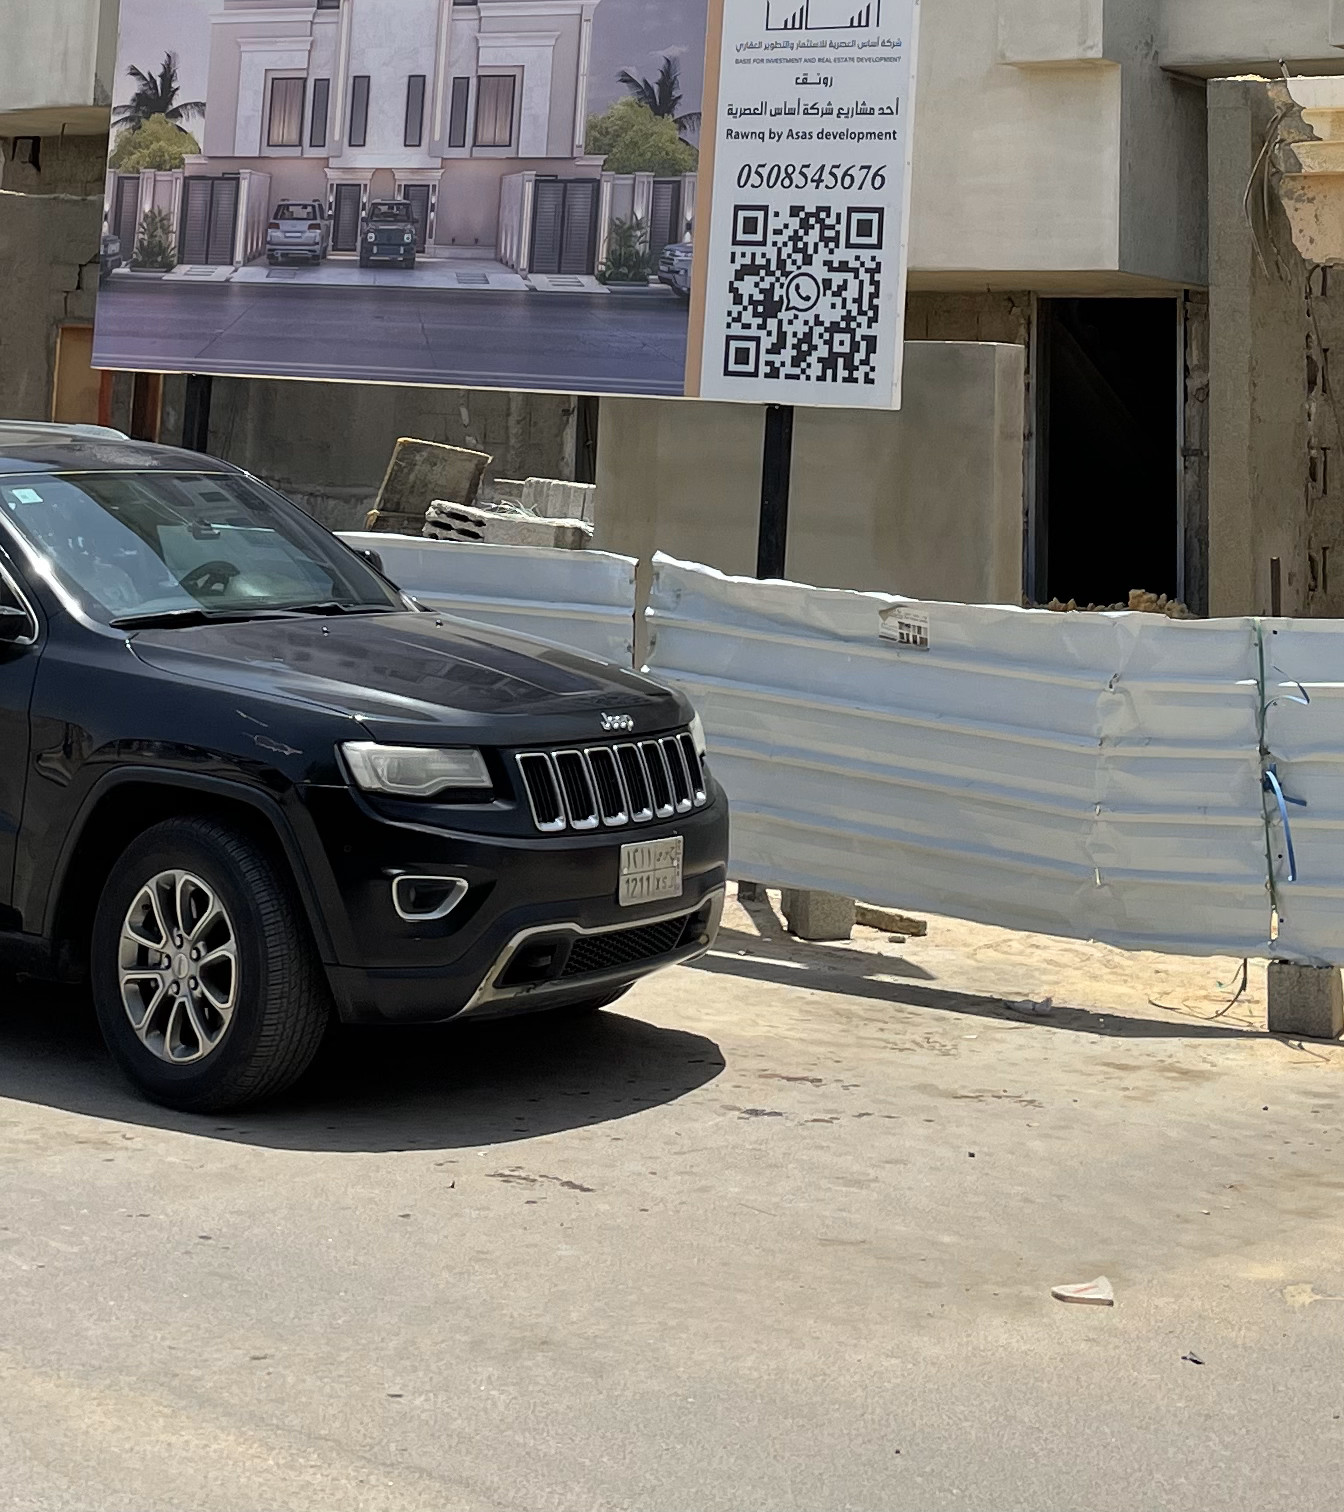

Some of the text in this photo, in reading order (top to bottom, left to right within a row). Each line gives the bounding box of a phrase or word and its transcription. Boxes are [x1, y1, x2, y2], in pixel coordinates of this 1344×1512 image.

[726, 96, 900, 119] أحد مشاريع شركة أساس العصرية
[725, 128, 898, 144] Rawnq by Asas development
[736, 162, 887, 191] 0508545676
[599, 711, 635, 732] Jeep
[625, 874, 651, 899] 1211
